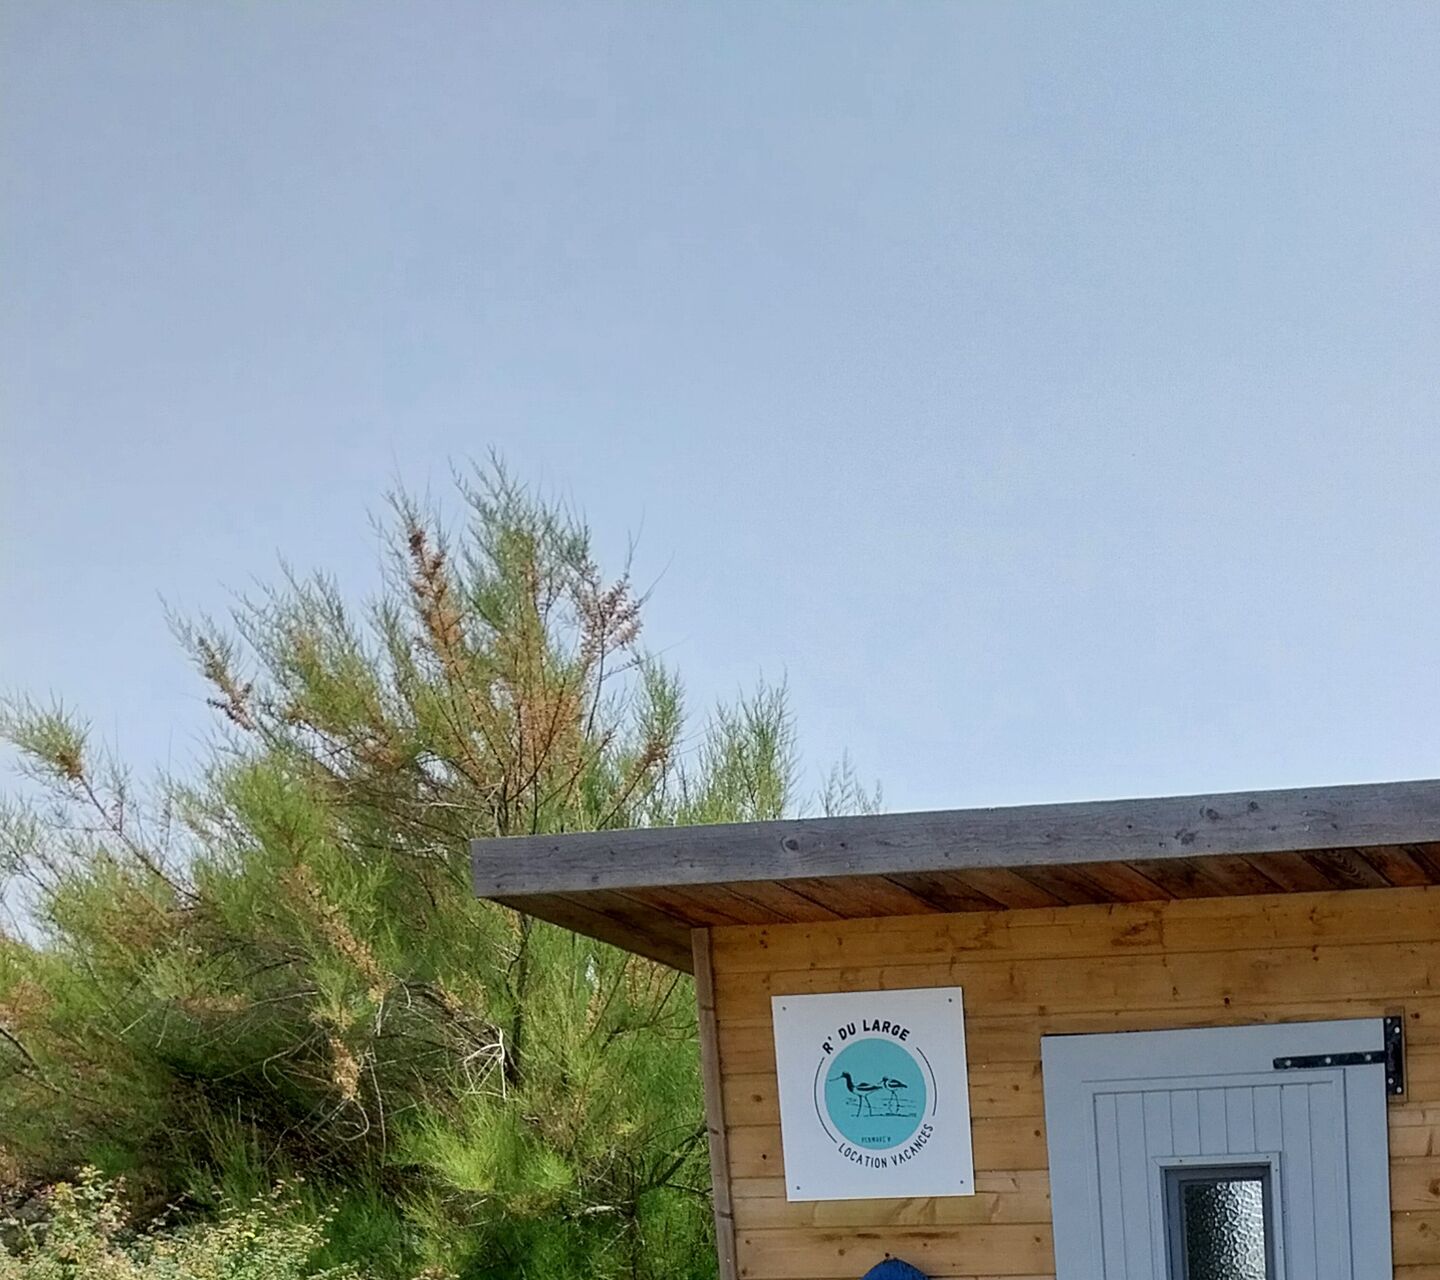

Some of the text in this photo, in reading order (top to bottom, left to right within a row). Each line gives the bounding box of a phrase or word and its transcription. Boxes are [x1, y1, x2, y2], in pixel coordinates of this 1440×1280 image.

[838, 1022, 856, 1040] DU
[862, 1019, 910, 1041] LARGE
[838, 1123, 934, 1169] LOCATION VACANCES
